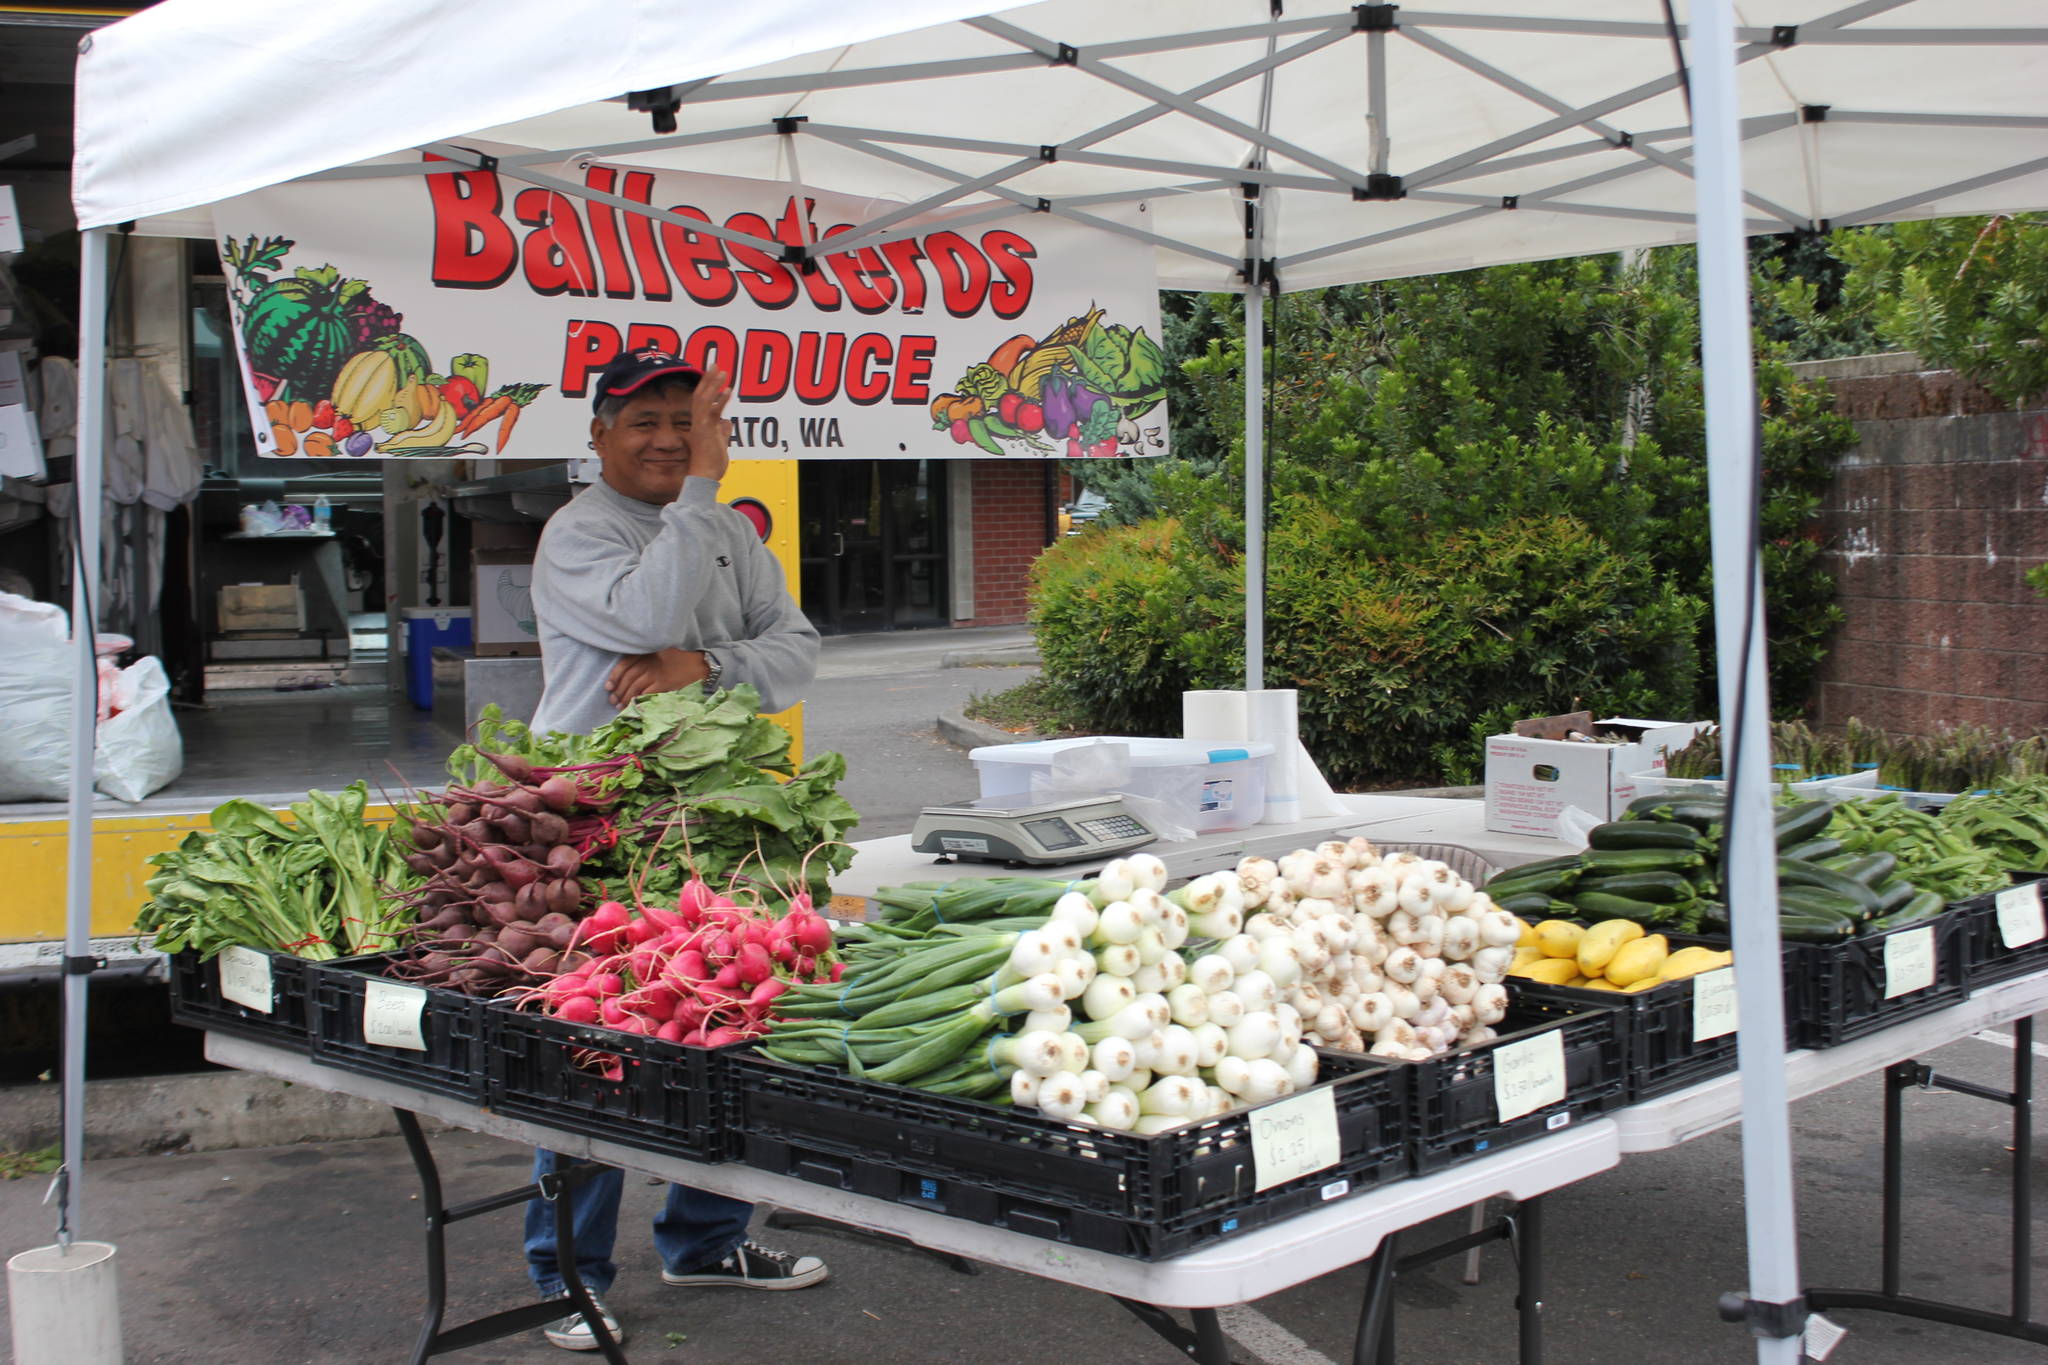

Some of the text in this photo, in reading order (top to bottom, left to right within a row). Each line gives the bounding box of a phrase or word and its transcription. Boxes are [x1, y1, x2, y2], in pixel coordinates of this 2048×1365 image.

[424, 151, 1038, 320] Ballesteros
[799, 417, 844, 448] WA
[1261, 1113, 1305, 1140] Onions
